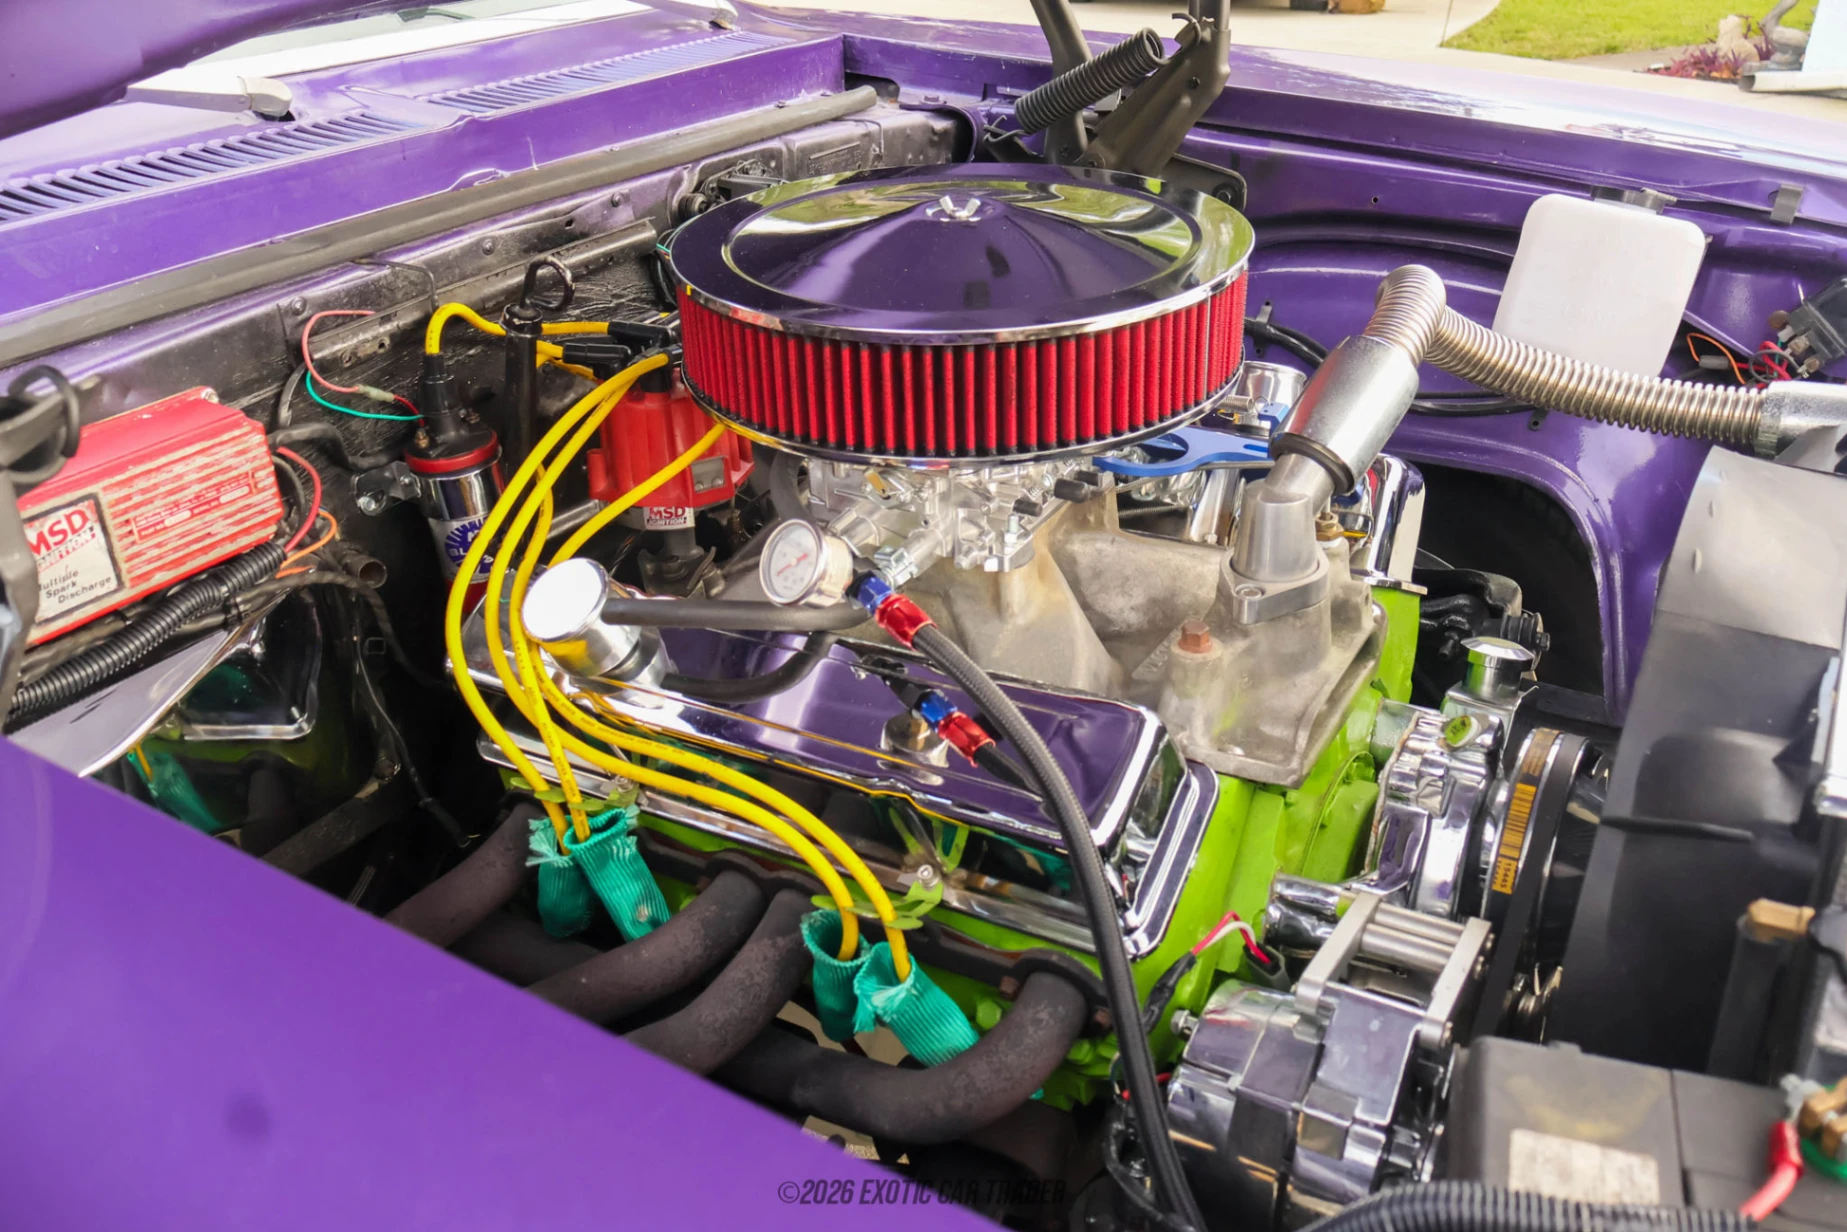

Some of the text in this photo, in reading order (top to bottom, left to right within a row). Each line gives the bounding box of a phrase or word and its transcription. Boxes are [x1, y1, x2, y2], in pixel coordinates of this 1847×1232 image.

[649, 505, 686, 519] MSD
[29, 509, 89, 556] MSD
[39, 569, 79, 591] ultiple
[45, 581, 77, 598] Spark
[58, 577, 112, 603] Discharge
